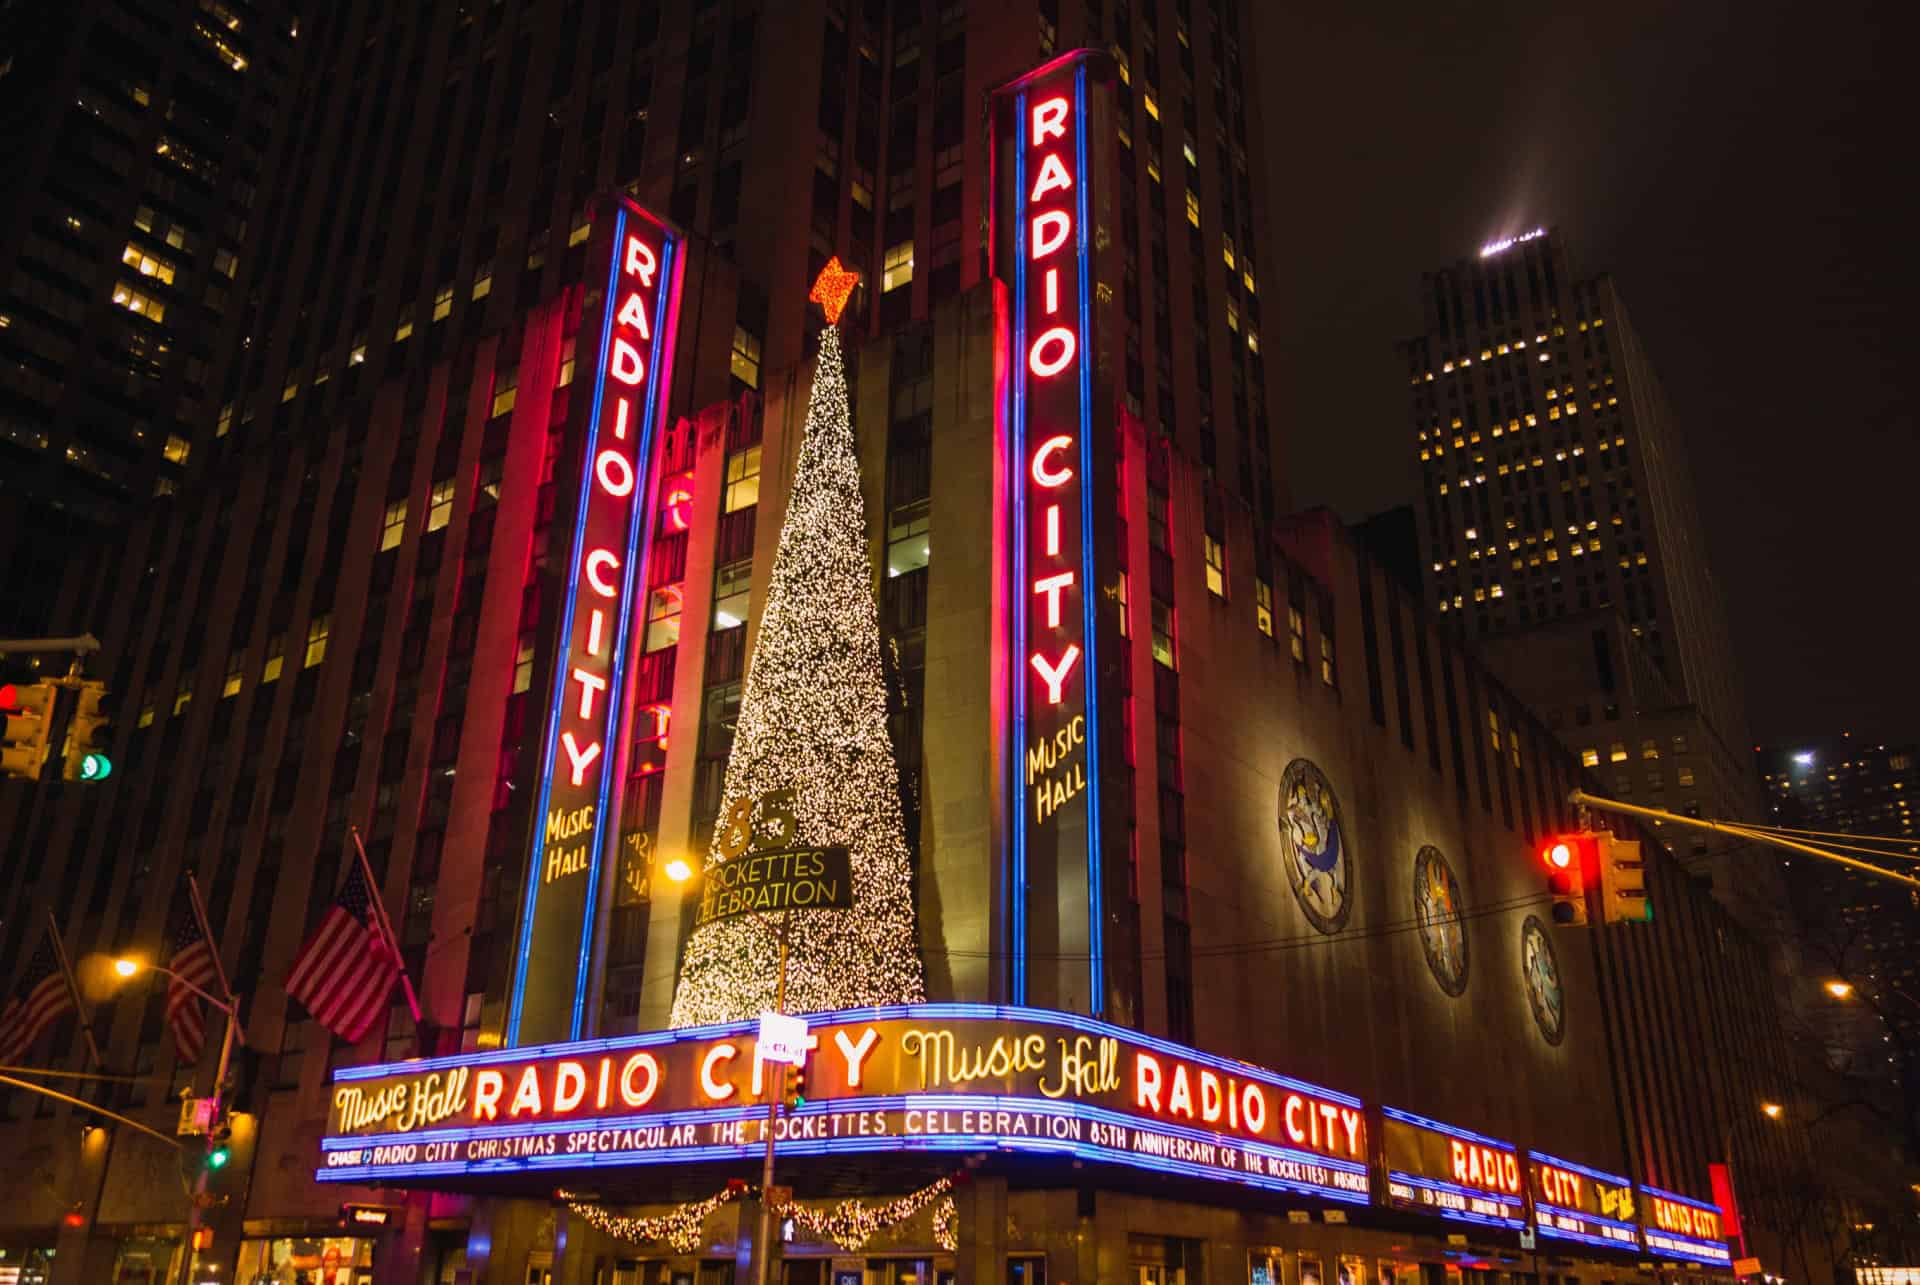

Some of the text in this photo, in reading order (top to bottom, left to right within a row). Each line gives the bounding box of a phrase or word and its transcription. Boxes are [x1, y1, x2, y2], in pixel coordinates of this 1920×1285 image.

[1029, 98, 1080, 705] RADIO CITY
[561, 236, 657, 786] RADIO CITY
[719, 788, 798, 859] 85
[335, 1027, 1360, 1155] Music Hall RADIO CIY Music Hall RADIO CITY
[372, 1144, 417, 1165] RADIO
[425, 1142, 459, 1162] CITY
[468, 1132, 555, 1159] CHRISTMAS
[711, 1121, 746, 1144] THE
[905, 1109, 1081, 1139] CELEBRATION
[1090, 1120, 1127, 1150] 85TH
[1133, 1132, 1216, 1165] ANNIVERSARY
[1220, 1146, 1238, 1168] OF
[1244, 1152, 1264, 1174] THE
[1451, 1139, 1519, 1192] RADIO
[1542, 1166, 1581, 1209] CITY
[1653, 1198, 1692, 1234] RADIO
[1692, 1208, 1719, 1240] CITY
